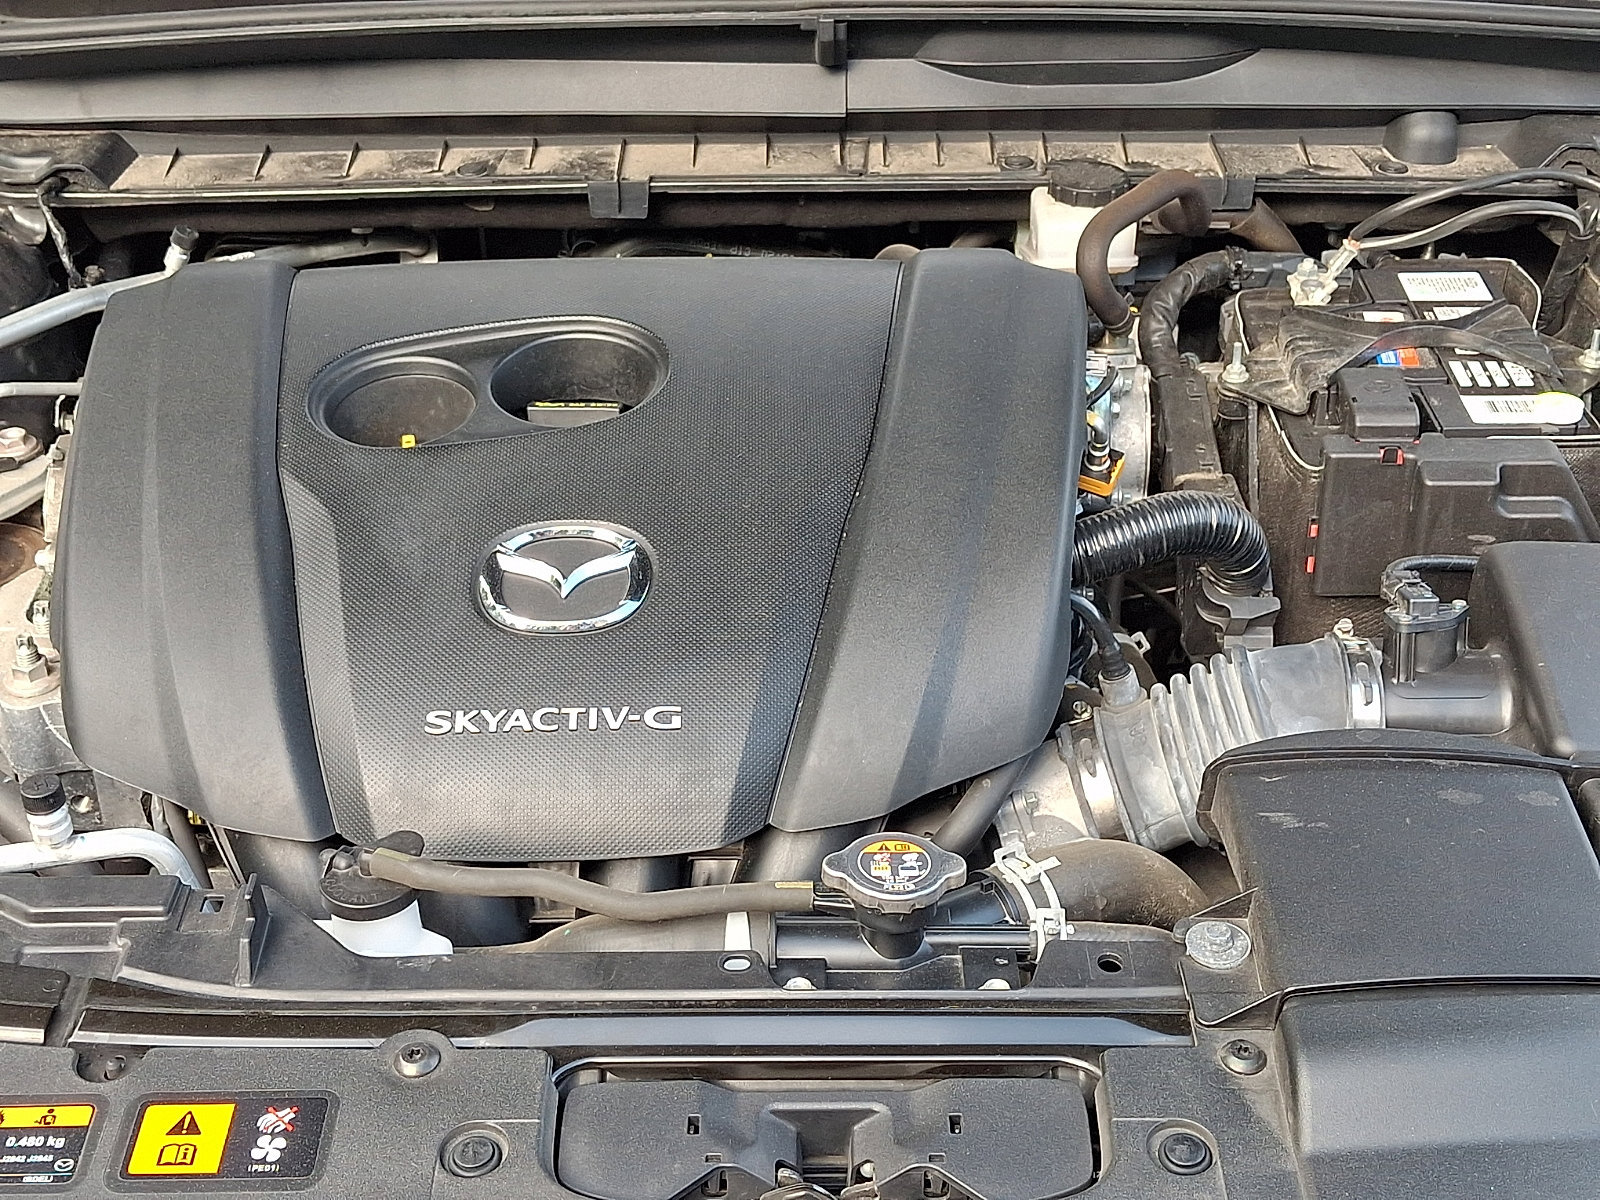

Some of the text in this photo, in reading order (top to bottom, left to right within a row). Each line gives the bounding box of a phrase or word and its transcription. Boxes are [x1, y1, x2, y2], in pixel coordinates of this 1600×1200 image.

[424, 705, 682, 735] SKYACTIV-G
[325, 879, 380, 904] COOLANT
[46, 1135, 66, 1149] kg
